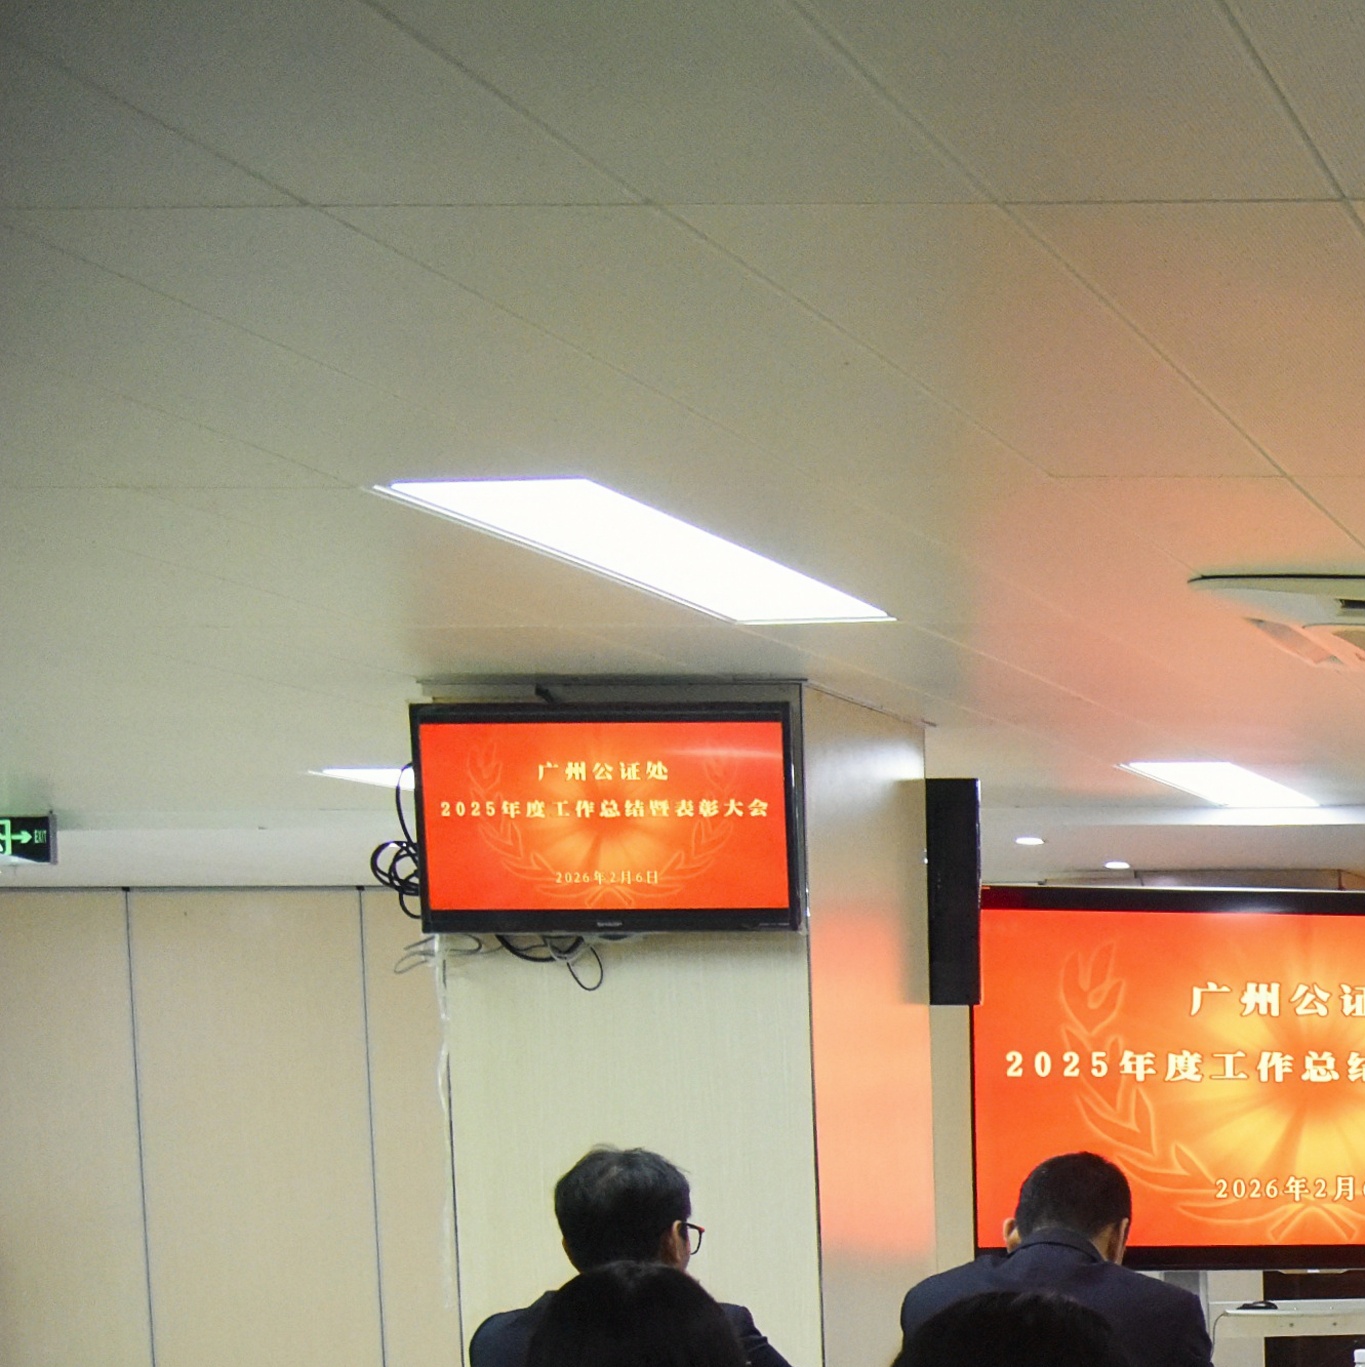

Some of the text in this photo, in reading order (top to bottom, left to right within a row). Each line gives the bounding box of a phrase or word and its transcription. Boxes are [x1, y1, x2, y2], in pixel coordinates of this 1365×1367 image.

[537, 761, 669, 782] 广州公证处
[440, 798, 769, 818] 2025年度工作总结暨表彰大会
[555, 870, 659, 885] 2026年2月6日
